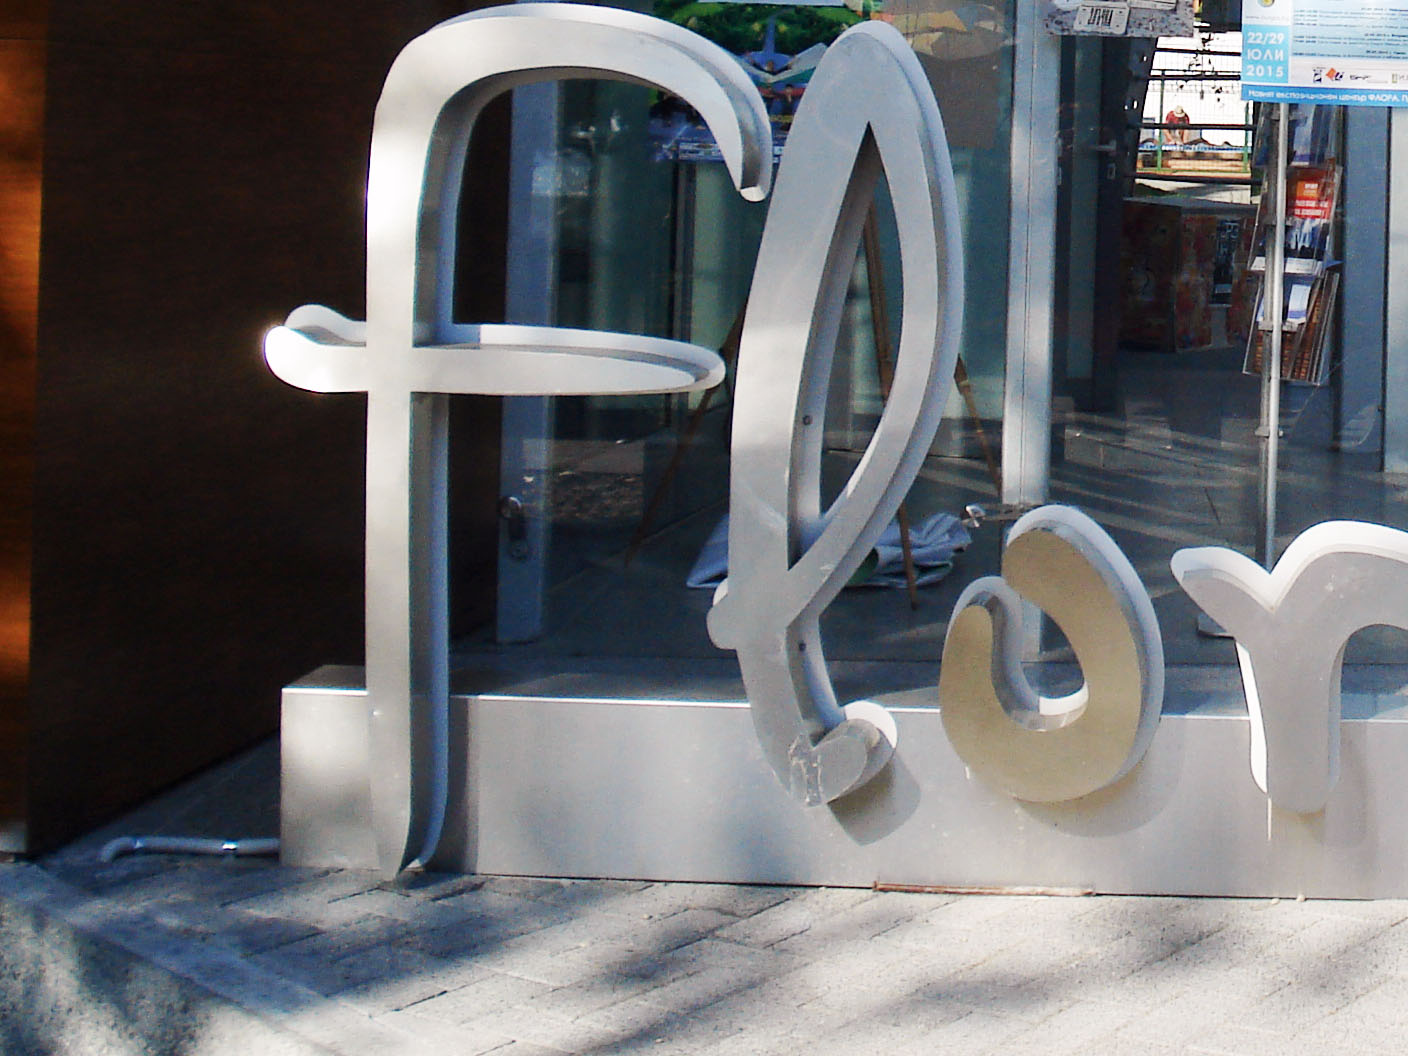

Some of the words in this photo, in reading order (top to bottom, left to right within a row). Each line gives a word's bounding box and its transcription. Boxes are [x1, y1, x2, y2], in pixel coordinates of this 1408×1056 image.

[1247, 32, 1284, 45] 22/29
[1247, 48, 1284, 62] ЮЛИ
[1246, 65, 1284, 78] 2015
